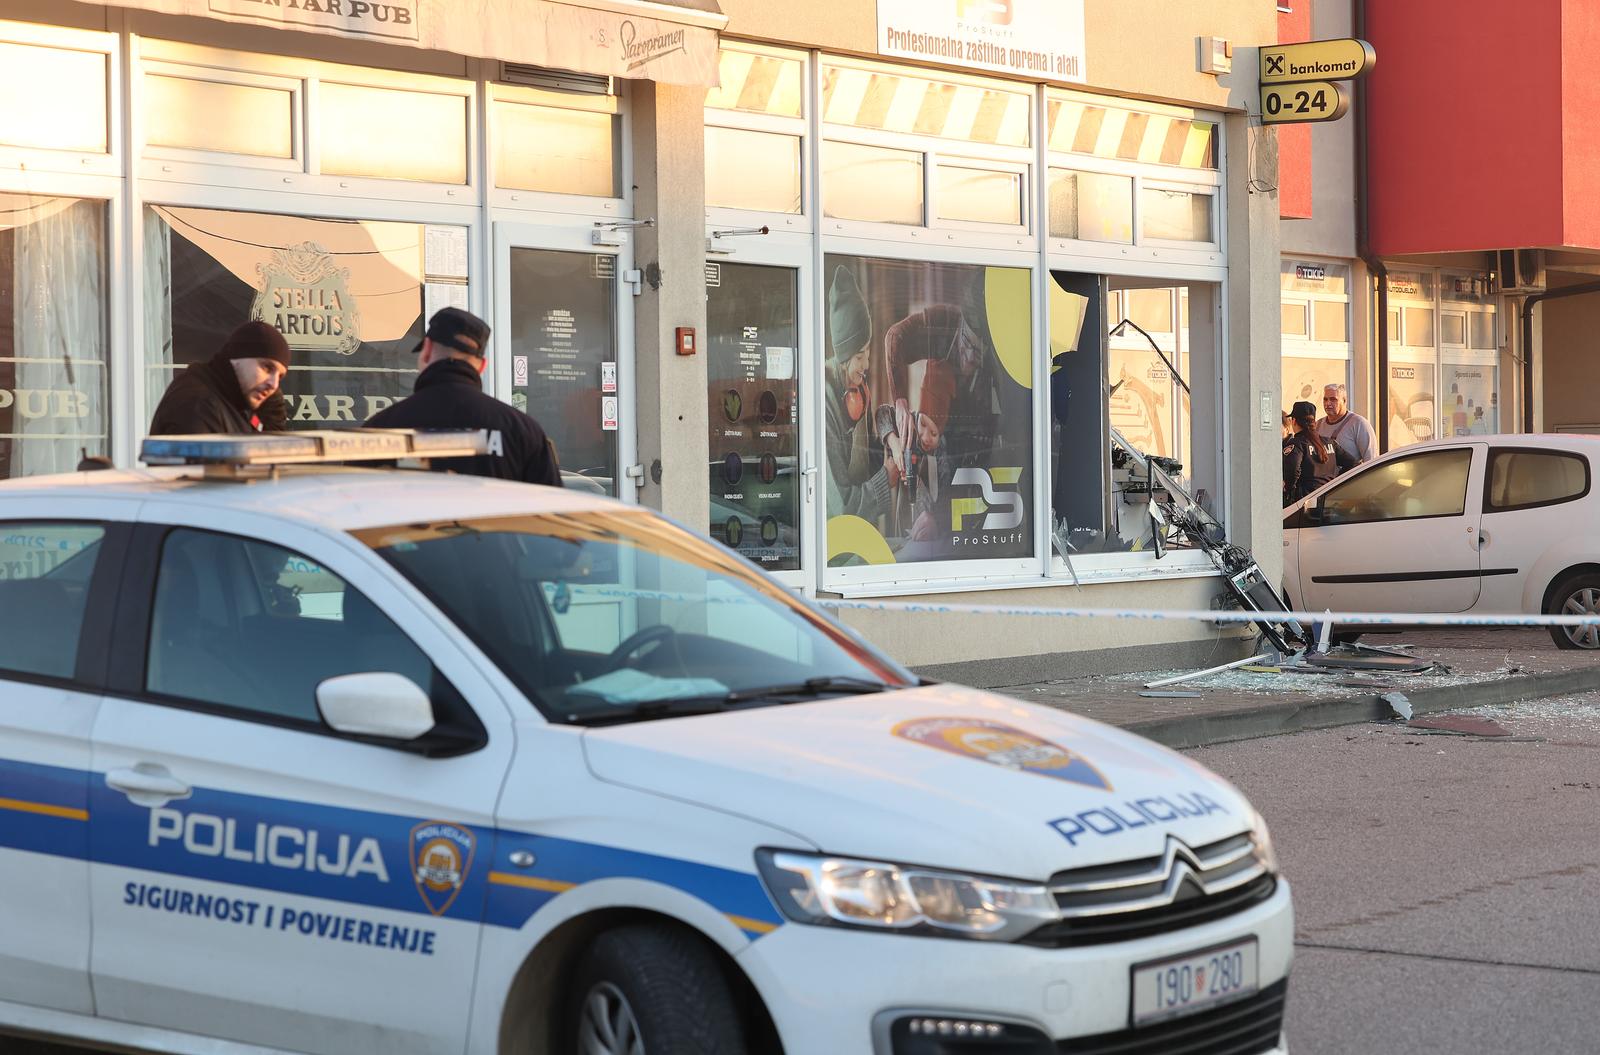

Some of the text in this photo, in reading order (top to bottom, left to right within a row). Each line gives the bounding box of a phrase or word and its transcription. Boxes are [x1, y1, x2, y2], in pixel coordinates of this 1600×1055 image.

[348, 0, 412, 24] PUB
[620, 20, 684, 62] Staropramen
[887, 27, 1078, 76] Profesionalna zaštitna oprema i alati
[1290, 60, 1356, 75] bankomat
[1266, 90, 1327, 115] 0-24
[273, 287, 342, 310] STELLA
[274, 313, 343, 336] ARTOIS
[953, 533, 1022, 546] ProStuff
[1046, 792, 1230, 846] POLICIJA
[148, 806, 390, 883] POLICIJA
[123, 882, 437, 956] SIGURNOST I POVJERENJE
[1157, 950, 1243, 1009] 190 280
